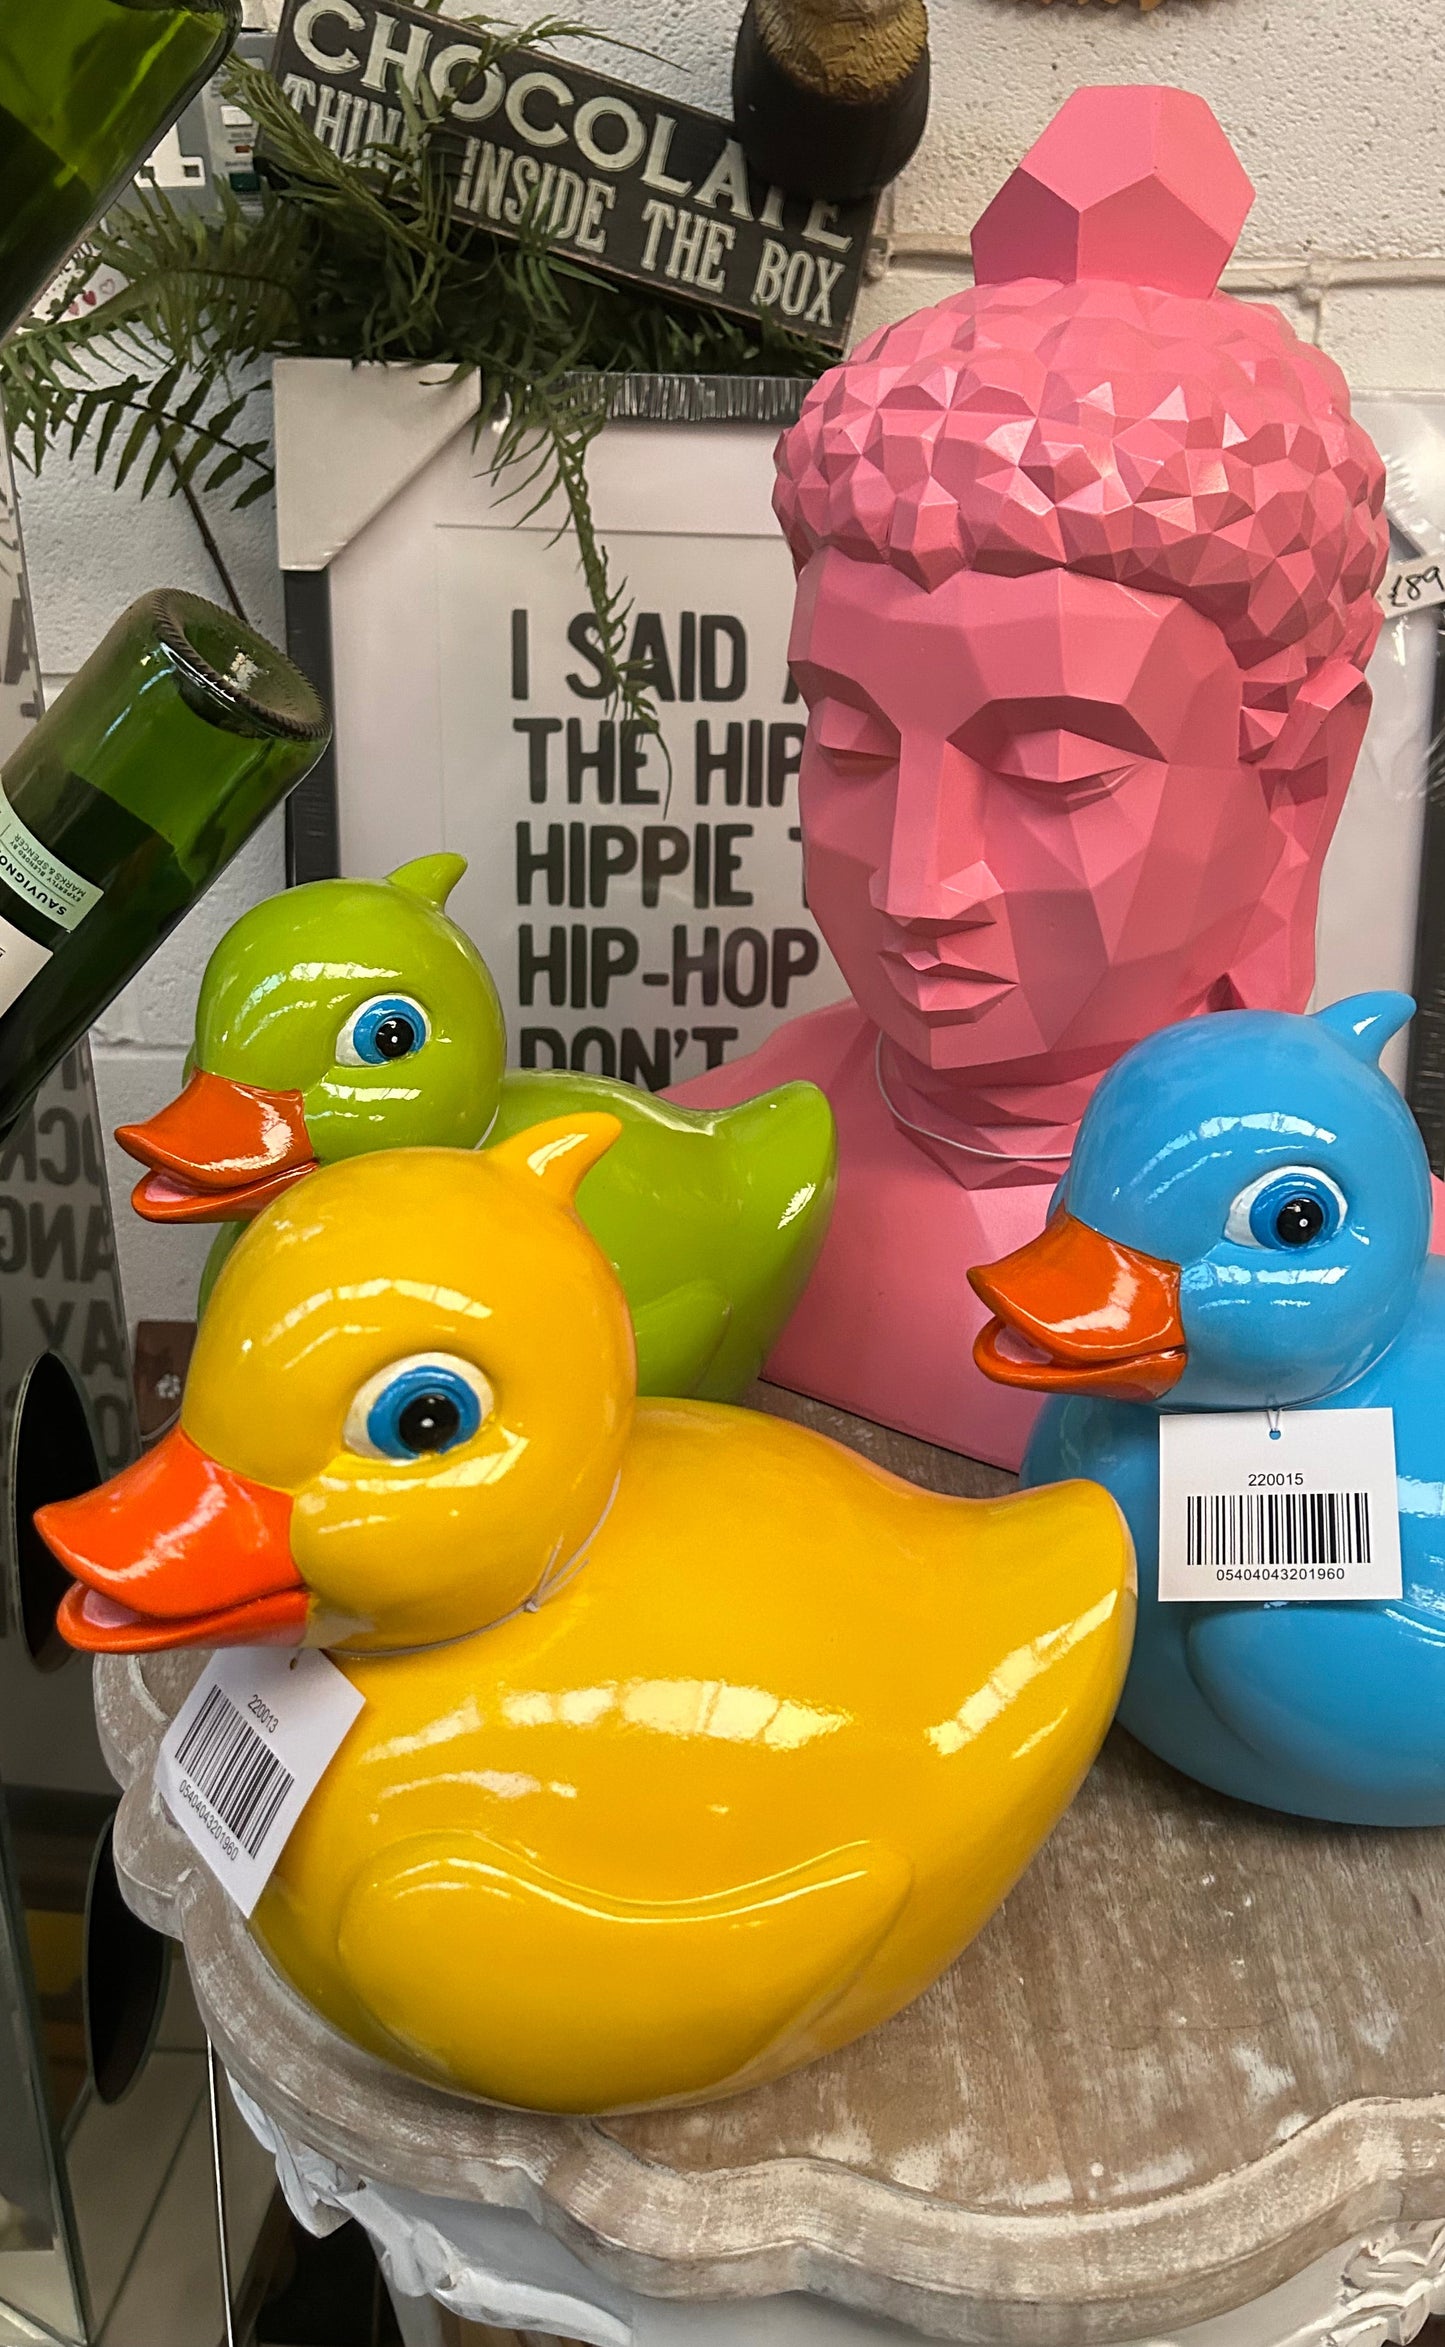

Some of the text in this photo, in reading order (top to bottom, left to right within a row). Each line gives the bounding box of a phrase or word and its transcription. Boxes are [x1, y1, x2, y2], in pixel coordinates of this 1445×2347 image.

[282, 72, 846, 328] THIN INSIDE THE BOX
[512, 609, 748, 702] I SAID
[513, 717, 807, 807] THE HIP
[0, 848, 67, 915] SAUVIGNO
[14, 833, 87, 897] MARKS & SPENCER
[18, 849, 46, 877] BLENDED
[516, 821, 754, 908] HIPPIE
[518, 924, 819, 1008] HIP-HOP
[1248, 1473, 1304, 1487] 220015
[1216, 1567, 1345, 1581] 05404043201960
[247, 1694, 280, 1734] 220013
[178, 1779, 239, 1862] 05404043201960
